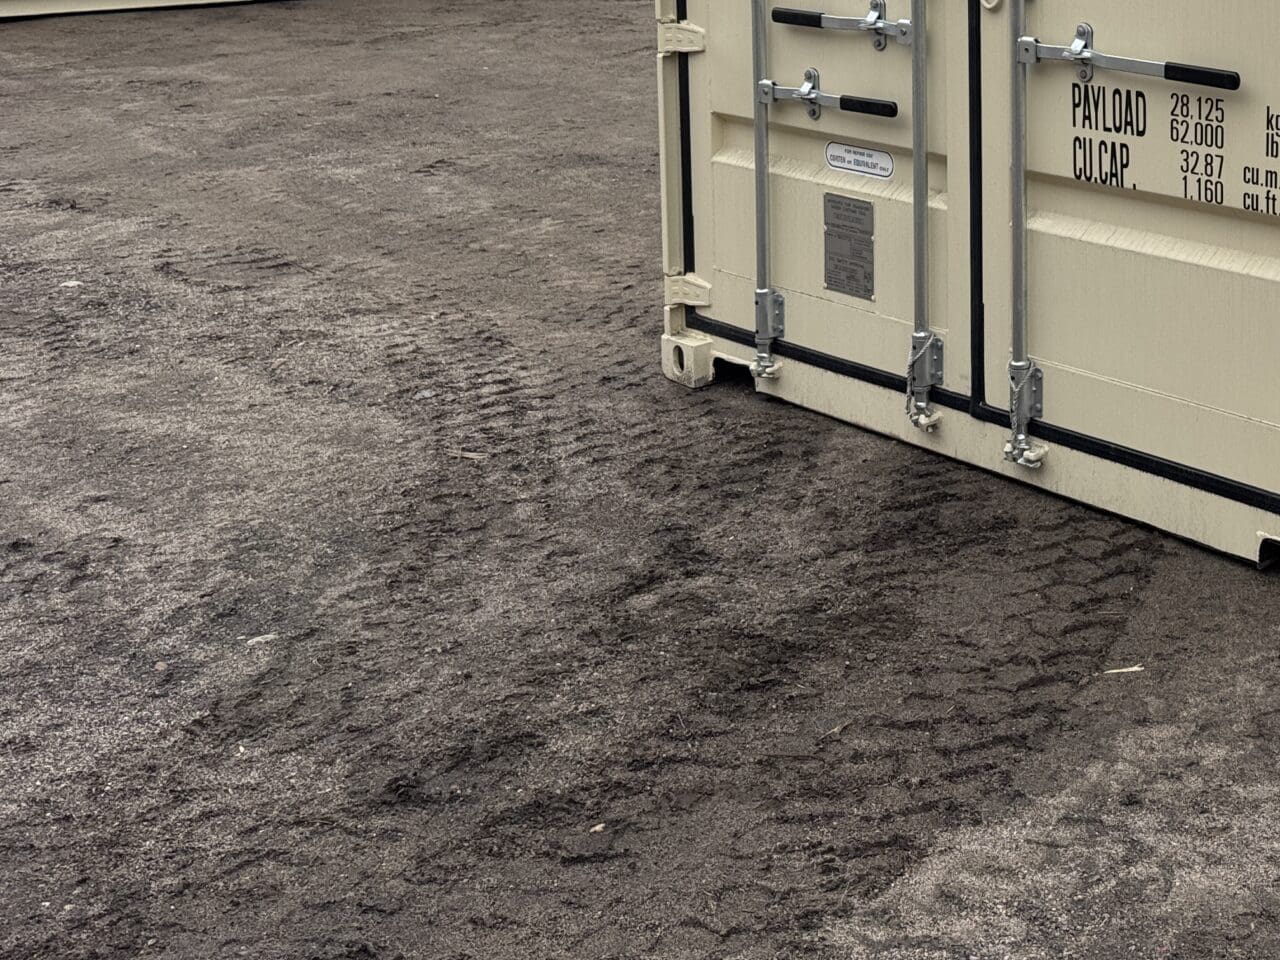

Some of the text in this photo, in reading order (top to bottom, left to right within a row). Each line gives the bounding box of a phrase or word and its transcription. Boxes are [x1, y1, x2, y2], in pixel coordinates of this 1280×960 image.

[1072, 82, 1147, 137] PAYLOAD
[1170, 92, 1225, 123] 28,125
[1170, 118, 1279, 158] 62,000 lb
[1180, 149, 1225, 179] 32.87
[1181, 174, 1225, 205] 1,160
